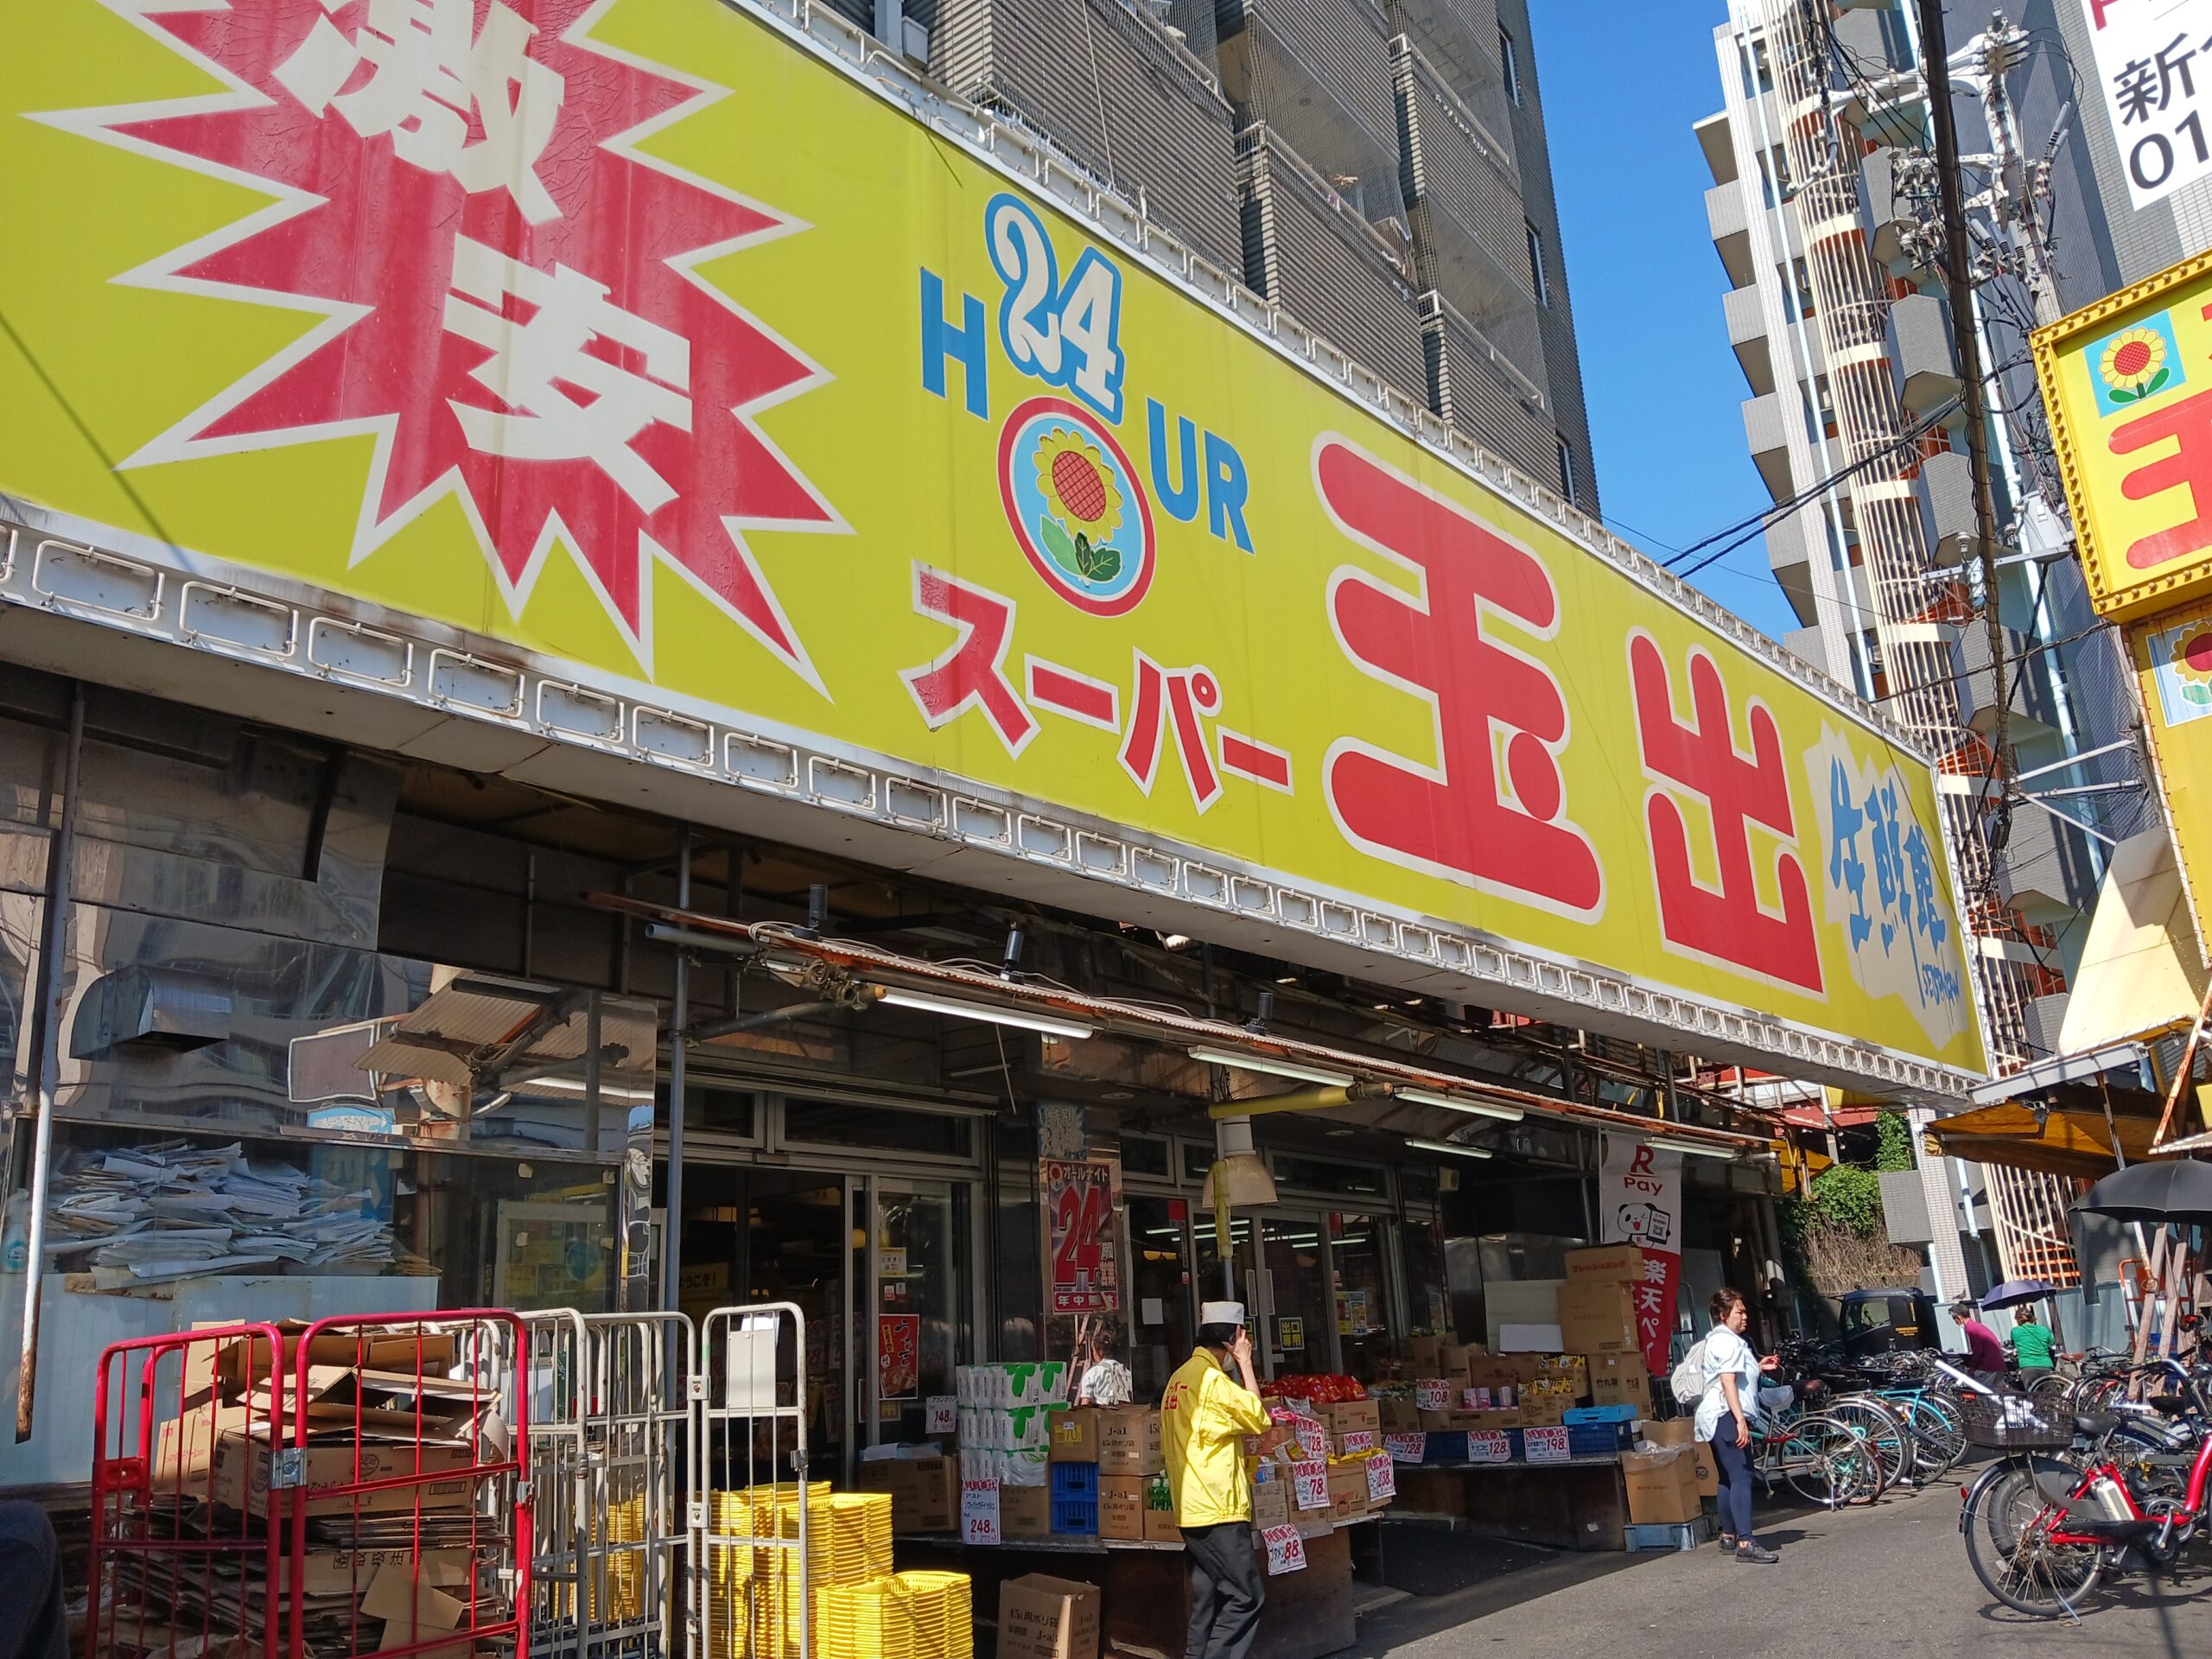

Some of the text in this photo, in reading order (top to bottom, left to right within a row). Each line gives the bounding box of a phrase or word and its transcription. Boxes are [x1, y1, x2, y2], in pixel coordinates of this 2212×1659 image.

[2113, 33, 2212, 126] 新
[272, 0, 693, 515] 激安
[986, 193, 1124, 425] 24
[898, 431, 1827, 1002] スーパー 玉出
[1630, 1144, 1655, 1176] R
[1063, 1165, 1109, 1183] オールナイト
[1624, 1177, 1663, 1197] Pay
[1054, 1185, 1102, 1287] 24
[1057, 1294, 1115, 1307] 年中無休
[1281, 1321, 1300, 1333] 出口
[1430, 1390, 1447, 1402] 108
[935, 1409, 950, 1422] 148
[1308, 1435, 1322, 1452] 128
[1403, 1443, 1421, 1454] 128
[1489, 1440, 1507, 1454] 128
[1546, 1438, 1565, 1452] 198
[1310, 1478, 1323, 1496] 78
[1284, 1540, 1300, 1560] 88
